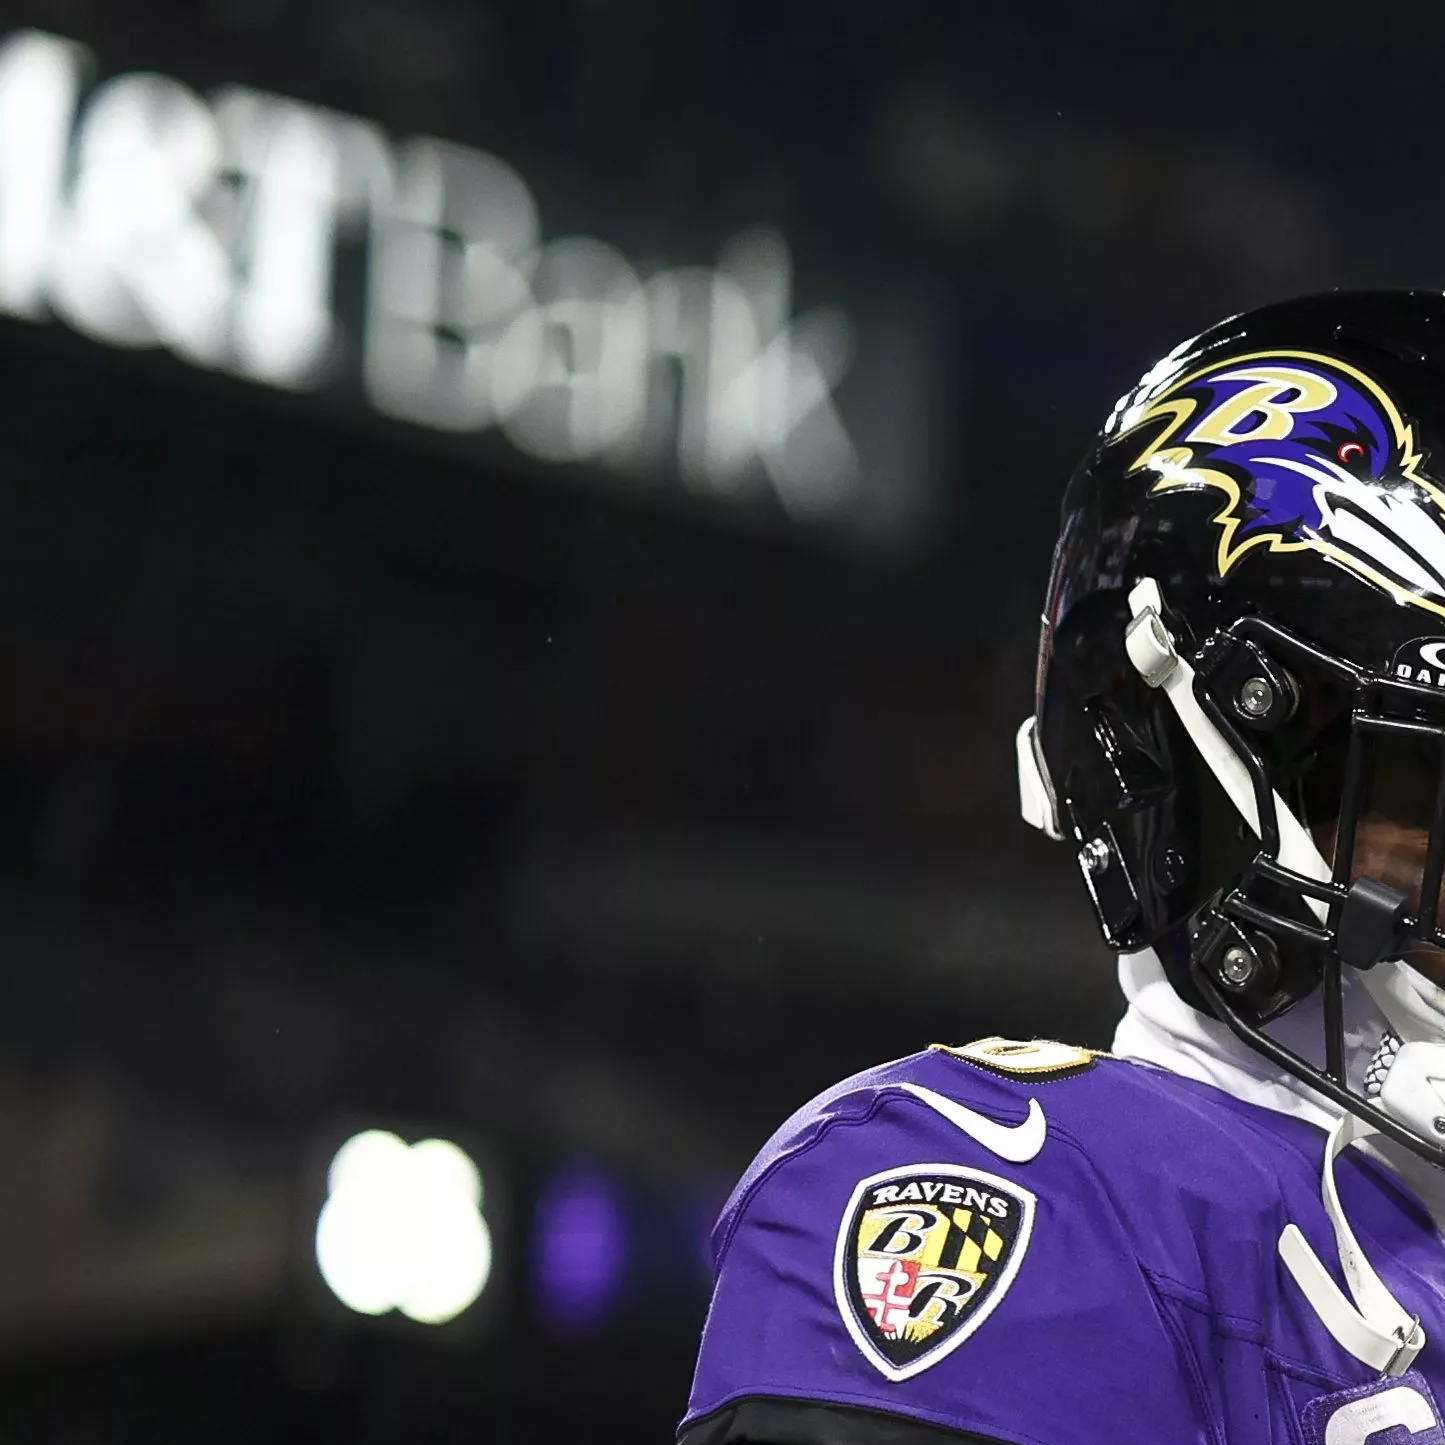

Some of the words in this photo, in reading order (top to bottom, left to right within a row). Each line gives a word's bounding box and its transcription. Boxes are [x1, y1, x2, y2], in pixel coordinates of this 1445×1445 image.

[365, 136, 858, 522] Bank
[1185, 367, 1338, 446] B
[872, 1181, 1009, 1219] RAVENS
[865, 1209, 940, 1258] B
[907, 1271, 978, 1327] R
